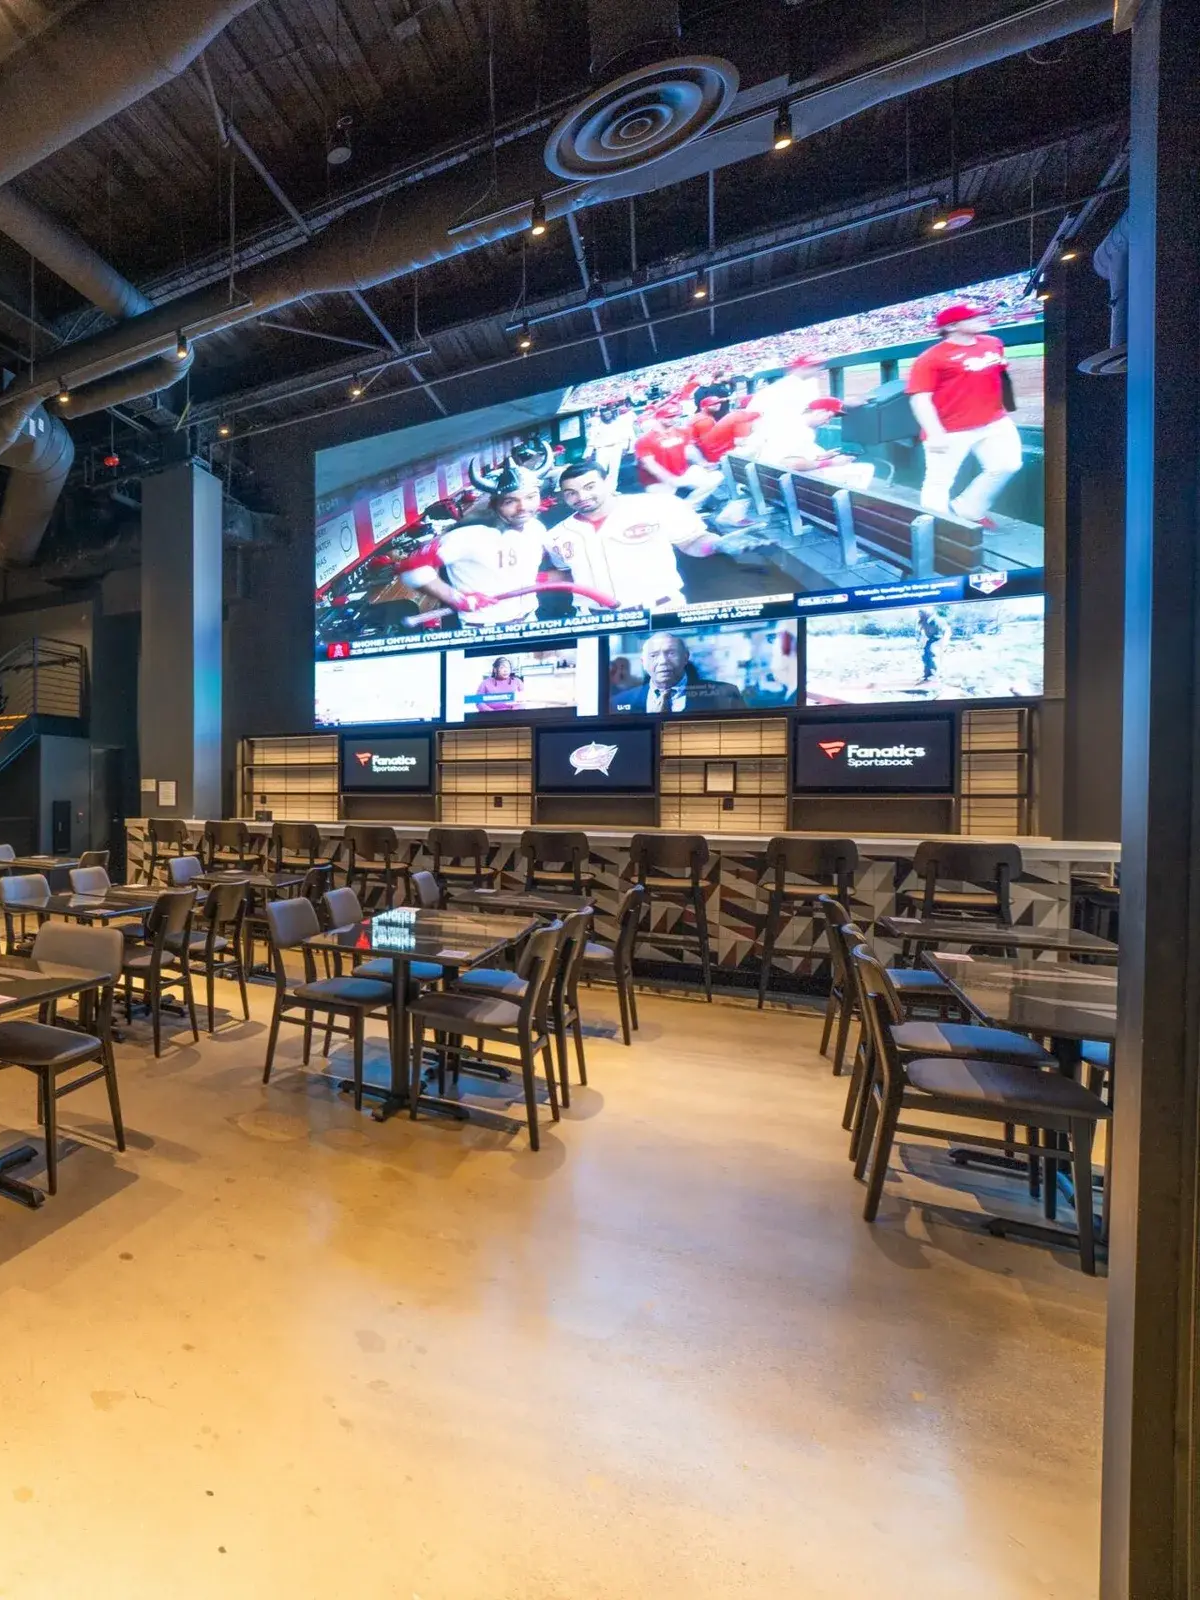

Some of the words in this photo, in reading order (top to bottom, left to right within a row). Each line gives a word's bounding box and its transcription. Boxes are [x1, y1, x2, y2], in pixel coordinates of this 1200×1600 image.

[677, 608, 720, 618] RANGERS
[680, 614, 716, 623] HEANEY
[352, 640, 385, 649] SHOHEI
[386, 635, 420, 645] OHTANI
[423, 630, 452, 642] (TORN
[454, 628, 477, 639] UCL)
[479, 623, 503, 635] WILL
[505, 622, 529, 633] NOT
[529, 619, 562, 630] PITCH
[564, 615, 600, 627] AGAIN
[602, 613, 615, 622] IN
[617, 611, 645, 621] 2023
[847, 744, 926, 758] Fanatics
[372, 754, 417, 766] Fanatics
[847, 758, 914, 768] Sportsbook
